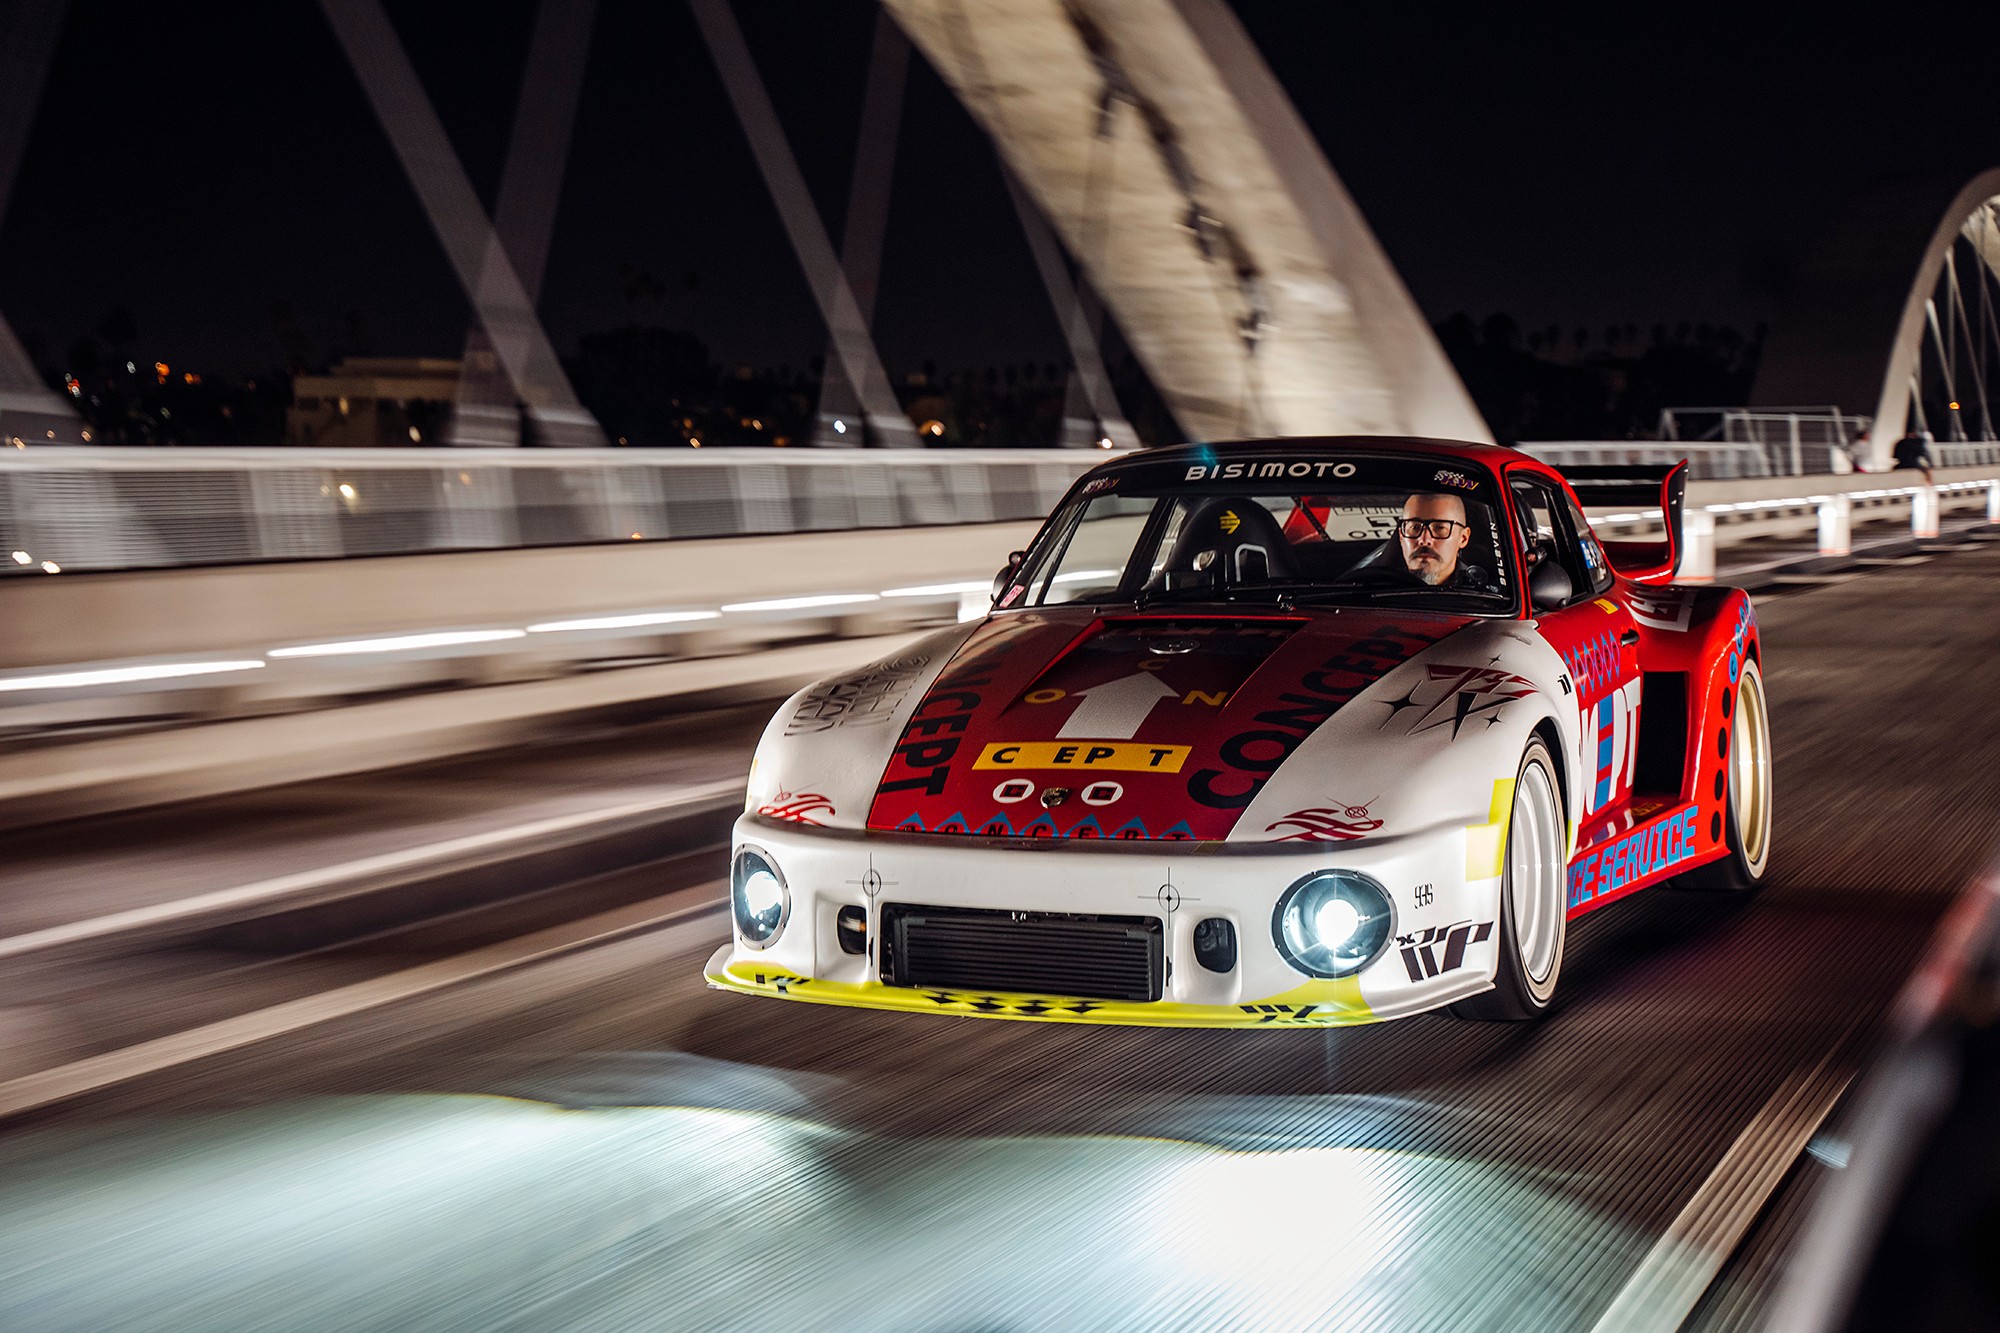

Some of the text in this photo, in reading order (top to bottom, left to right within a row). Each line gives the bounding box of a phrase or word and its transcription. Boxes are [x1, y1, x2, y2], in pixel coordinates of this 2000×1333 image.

[1184, 462, 1357, 481] BISIMOTO
[1187, 625, 1440, 809] CONCEPT
[1597, 805, 1699, 897] SERVICE
